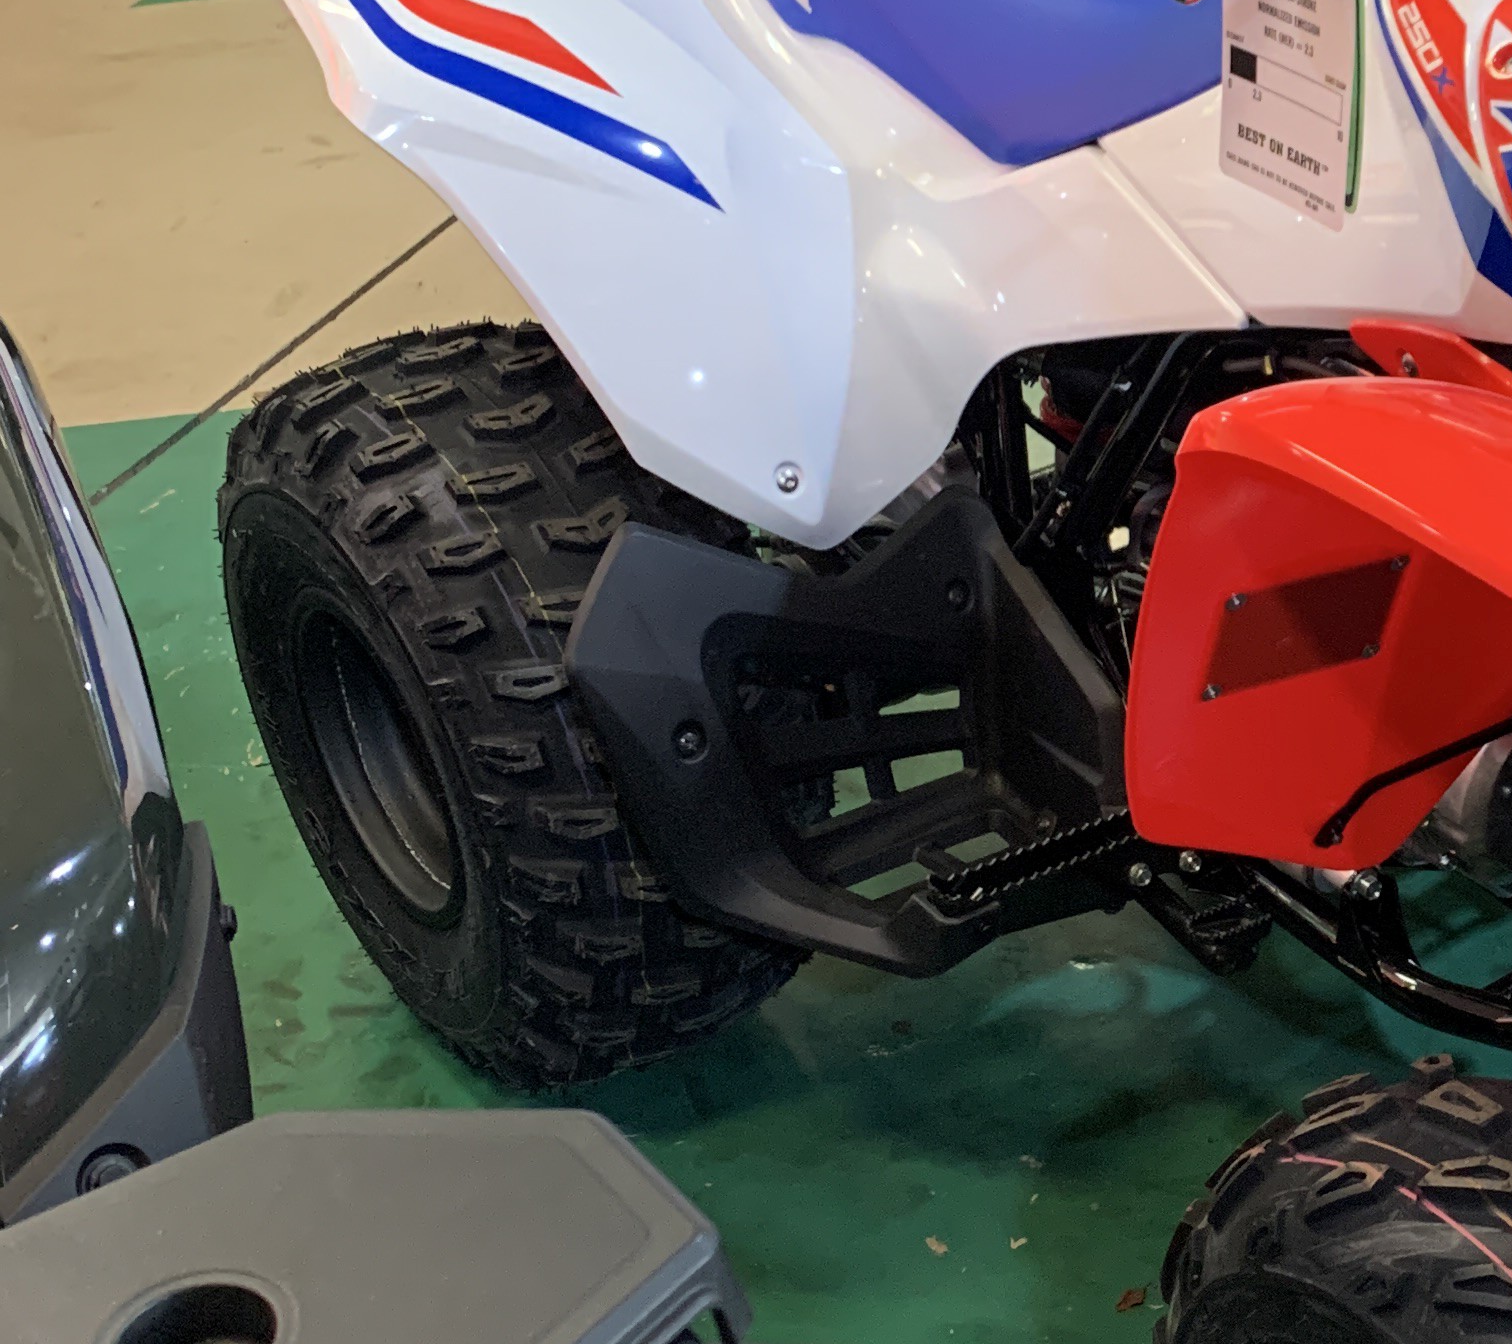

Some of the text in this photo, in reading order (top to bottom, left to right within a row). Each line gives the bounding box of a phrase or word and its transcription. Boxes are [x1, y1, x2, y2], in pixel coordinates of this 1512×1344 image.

[1258, 0, 1320, 37] NORMALIZED EMISSION
[1397, 0, 1456, 95] 250X
[1238, 122, 1266, 147] BEST
[1269, 138, 1284, 156] ON
